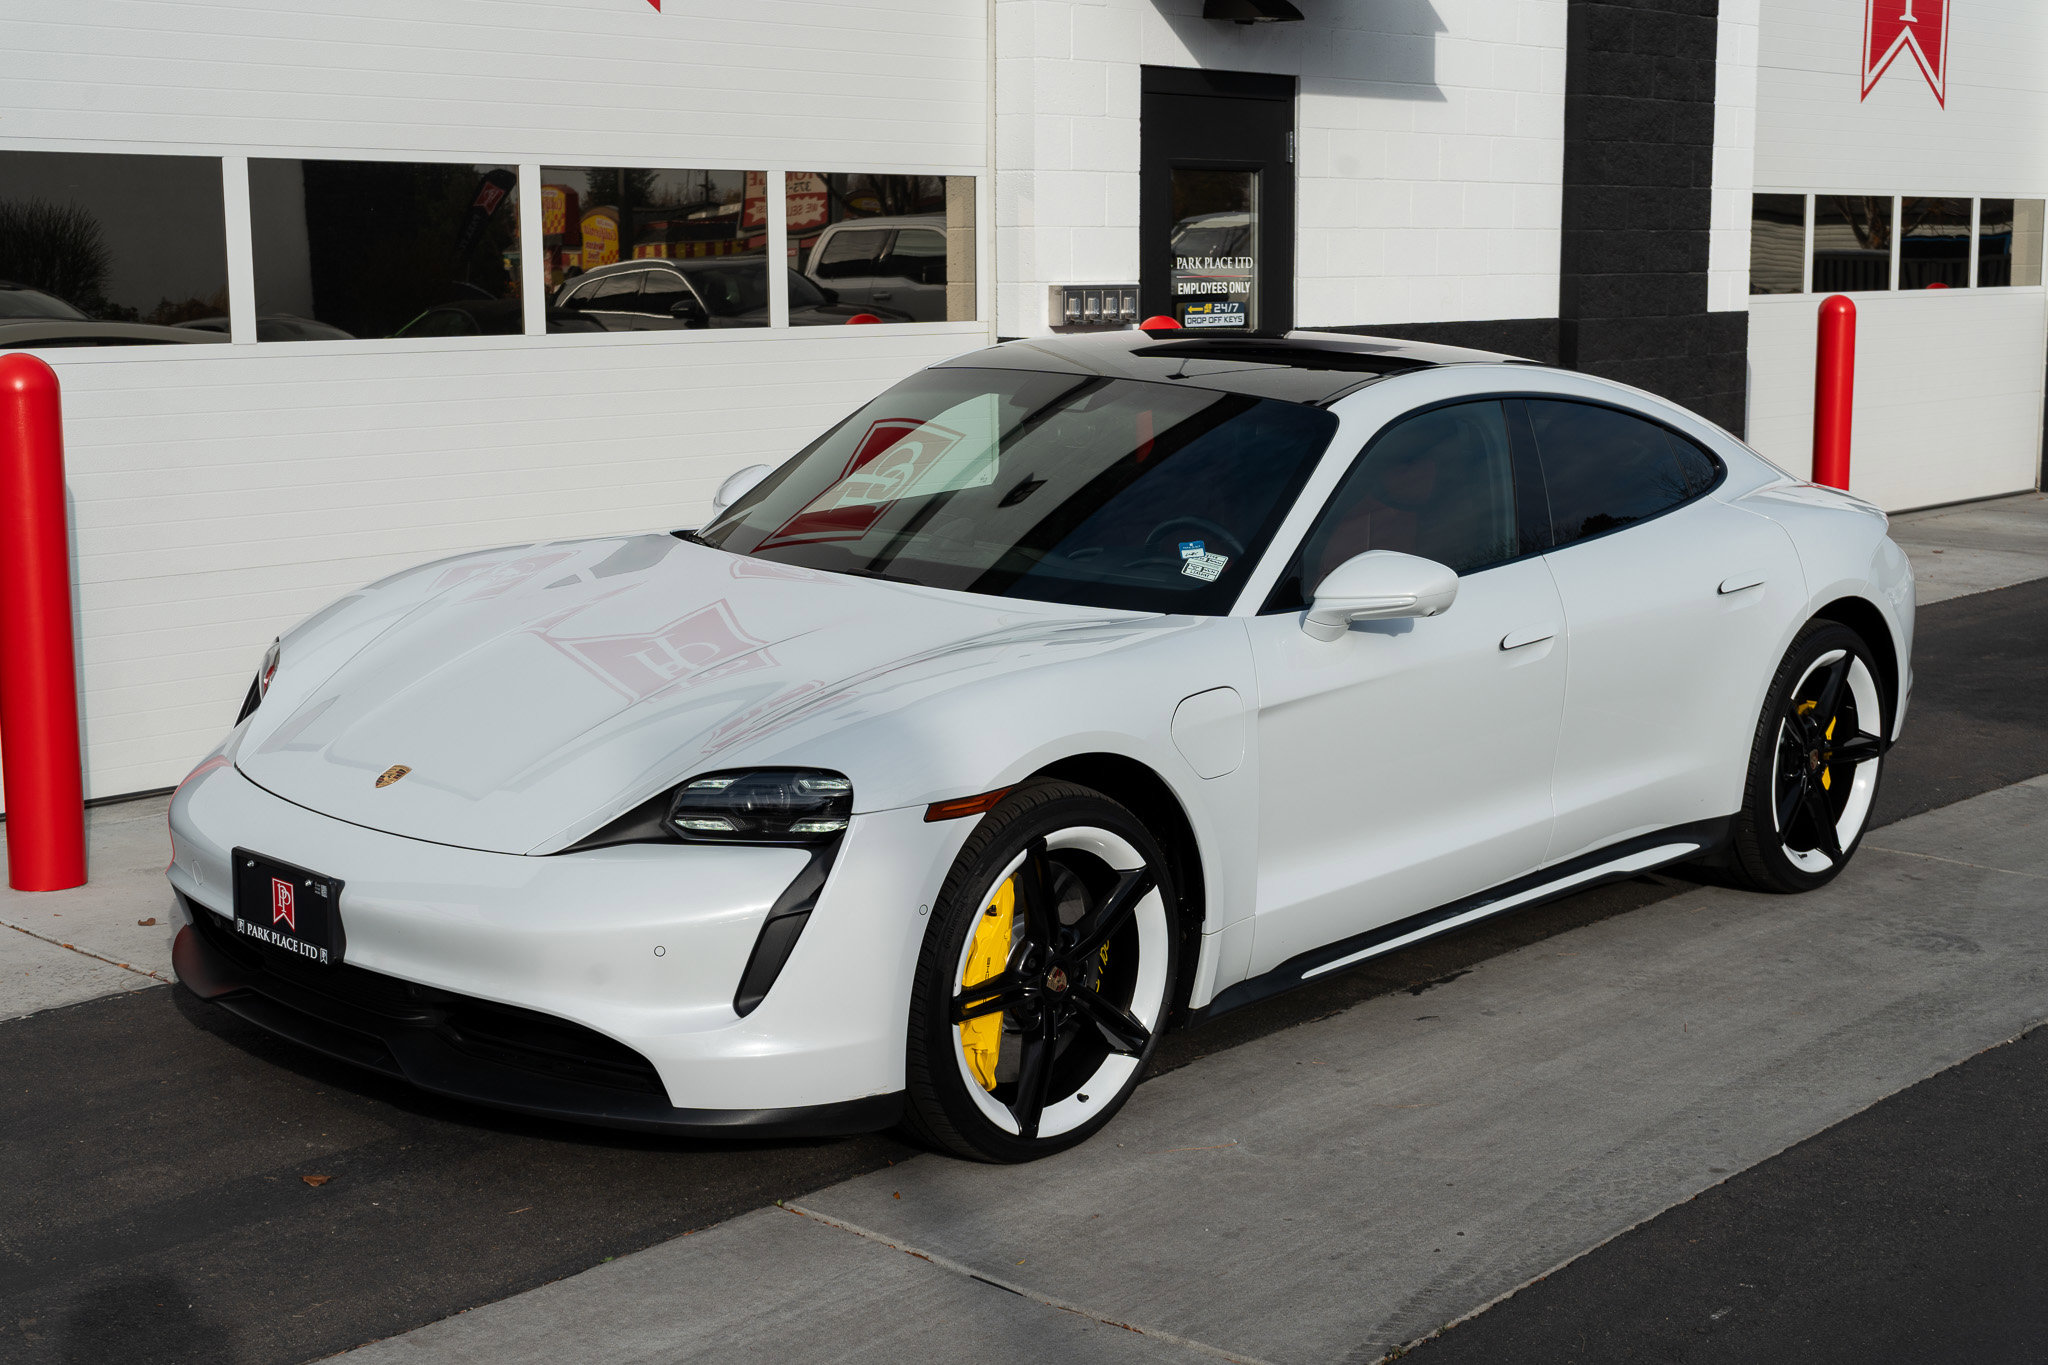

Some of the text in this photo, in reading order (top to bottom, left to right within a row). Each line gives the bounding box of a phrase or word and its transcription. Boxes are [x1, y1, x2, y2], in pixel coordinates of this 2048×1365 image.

[1177, 257, 1253, 269] PARK PLACE LTD
[1178, 281, 1251, 294] EMPLOYEES ONLY
[1214, 303, 1239, 313] 24/7
[1187, 316, 1207, 324] DROP
[1223, 315, 1242, 323] KEYS
[247, 923, 270, 942] PARK
[271, 932, 298, 952] PLACE
[299, 942, 318, 959] LTD
